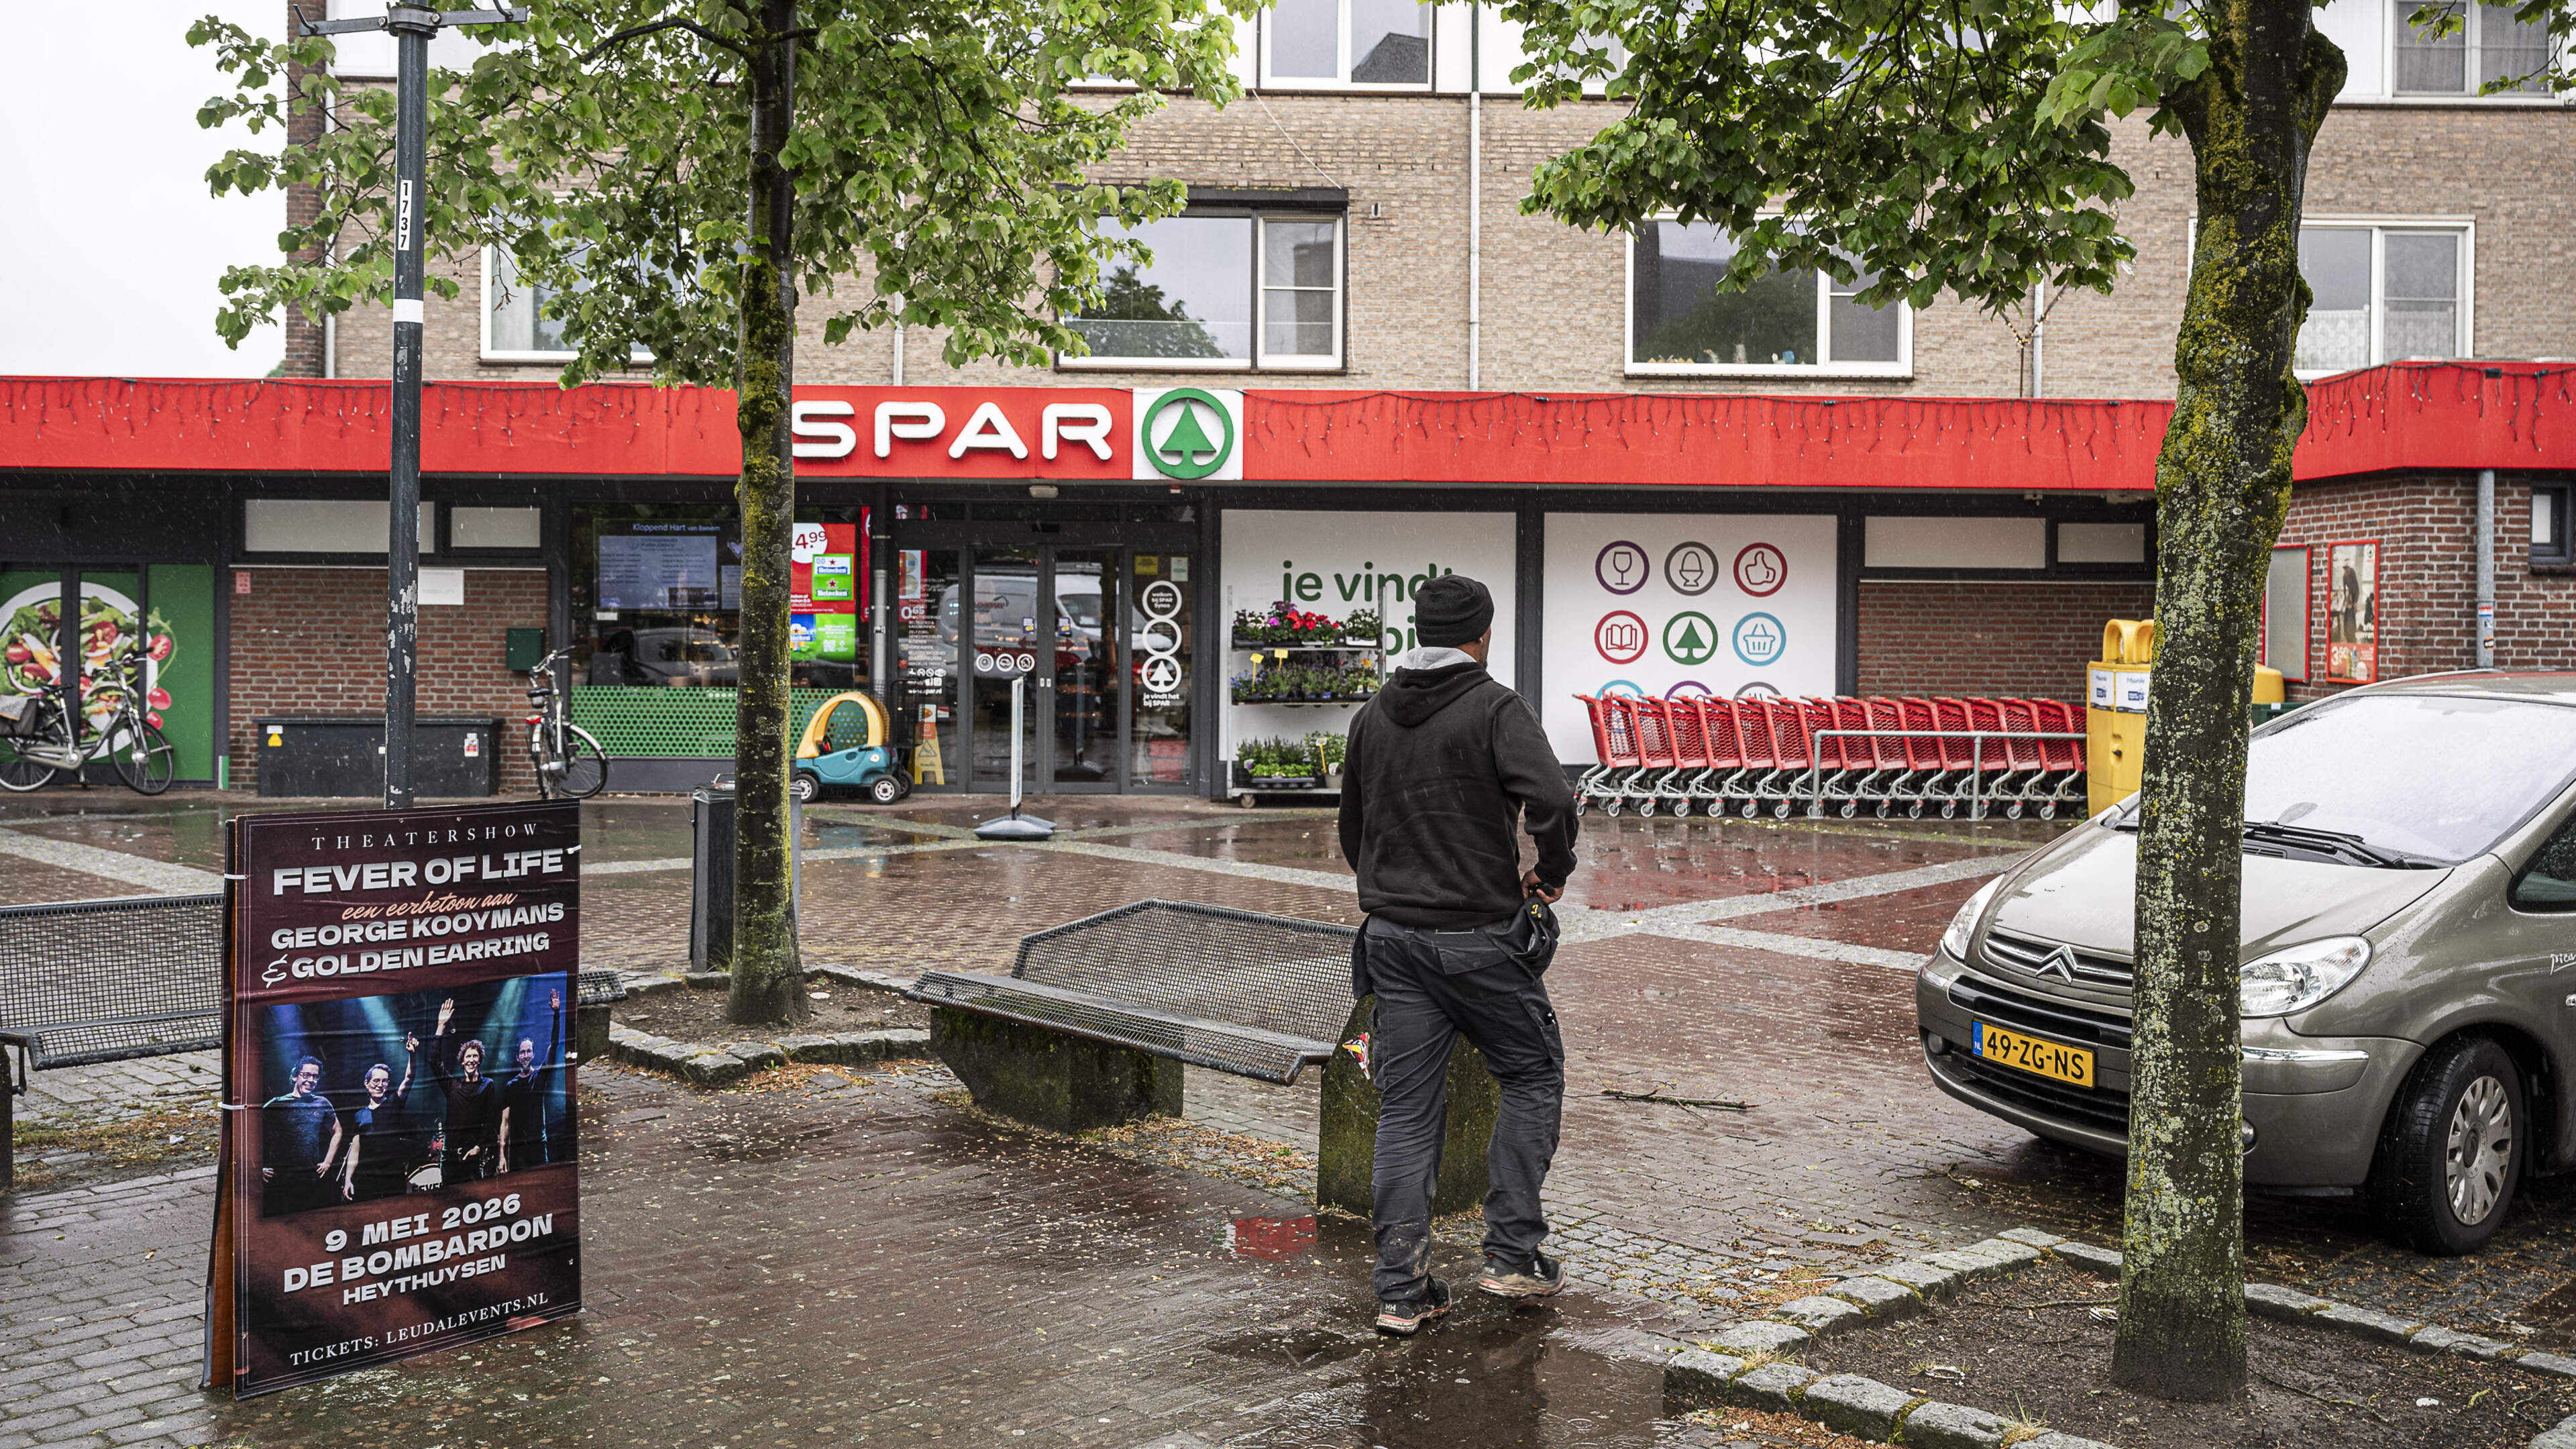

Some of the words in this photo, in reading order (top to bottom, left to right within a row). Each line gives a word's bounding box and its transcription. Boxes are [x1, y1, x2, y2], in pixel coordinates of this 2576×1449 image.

[400, 182, 409, 248] 1737
[792, 400, 1113, 460] SPAR
[633, 523, 668, 533] Kloppend
[669, 523, 686, 531] Hart
[1283, 560, 1323, 602] je
[312, 823, 537, 850] THEATERSHOW
[274, 861, 417, 896] FEVER
[425, 855, 476, 885] OF
[482, 848, 564, 880] LIFE
[271, 920, 407, 950] GEORGE
[413, 902, 565, 938] KOOYMANS
[341, 906, 383, 920] een
[386, 891, 482, 917] eerbetoon
[480, 892, 519, 907] aan
[261, 953, 288, 989] &
[291, 948, 423, 979] GOLDEN
[428, 932, 550, 966] EARRING
[1974, 1040, 1982, 1051] NL
[1987, 1031, 2084, 1080] 49-ZG-NS
[324, 1230, 348, 1254] 9
[362, 1212, 430, 1246] MEI
[442, 1193, 521, 1230] 2026
[284, 1261, 334, 1293] DE
[341, 1213, 553, 1283] BOMBARDON
[343, 1254, 506, 1306] HEYTHUYSEN
[290, 1336, 379, 1366] TICKETS:
[386, 1292, 549, 1344] LEUDALEVENTS.NL
[1385, 1303, 1396, 1311] HH
